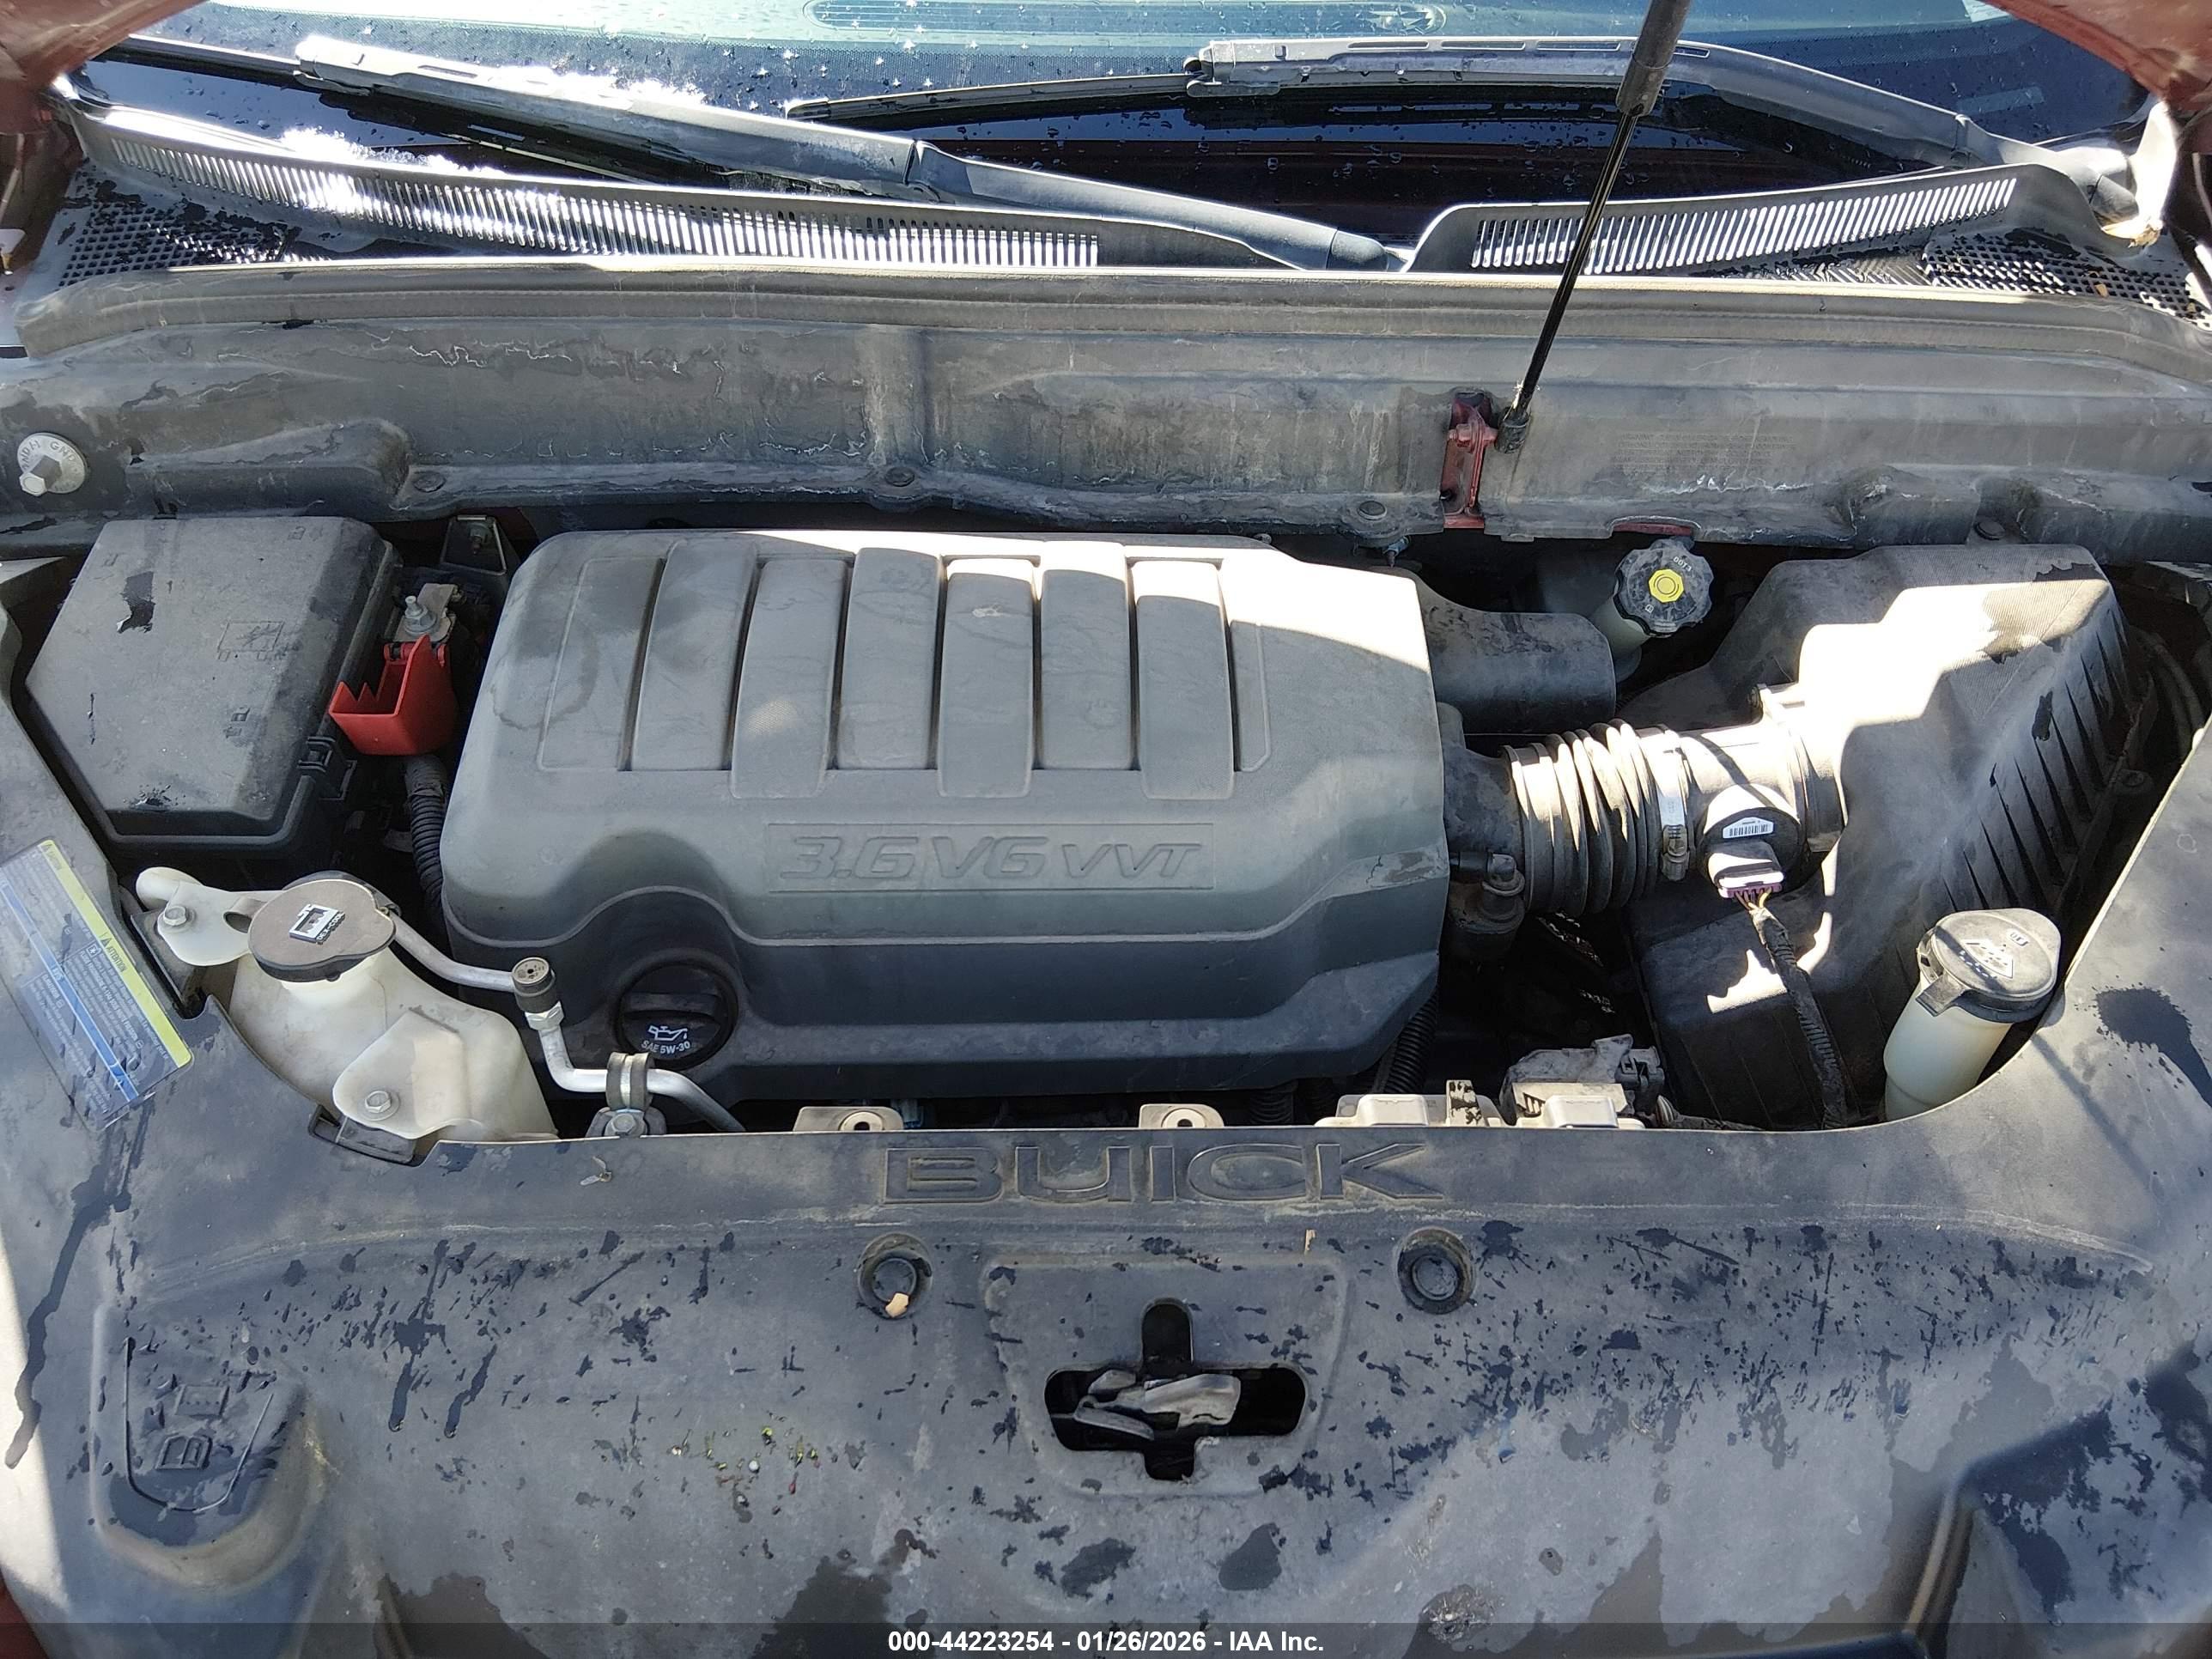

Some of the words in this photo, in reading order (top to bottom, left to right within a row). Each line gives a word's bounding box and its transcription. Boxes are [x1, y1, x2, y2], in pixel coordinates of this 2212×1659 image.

[1061, 843, 1202, 878] VVT
[316, 911, 346, 941] DEX-COOL
[641, 1040, 659, 1053] SAE
[659, 1040, 691, 1054] 5W-30
[882, 1143, 1443, 1202] BUICK
